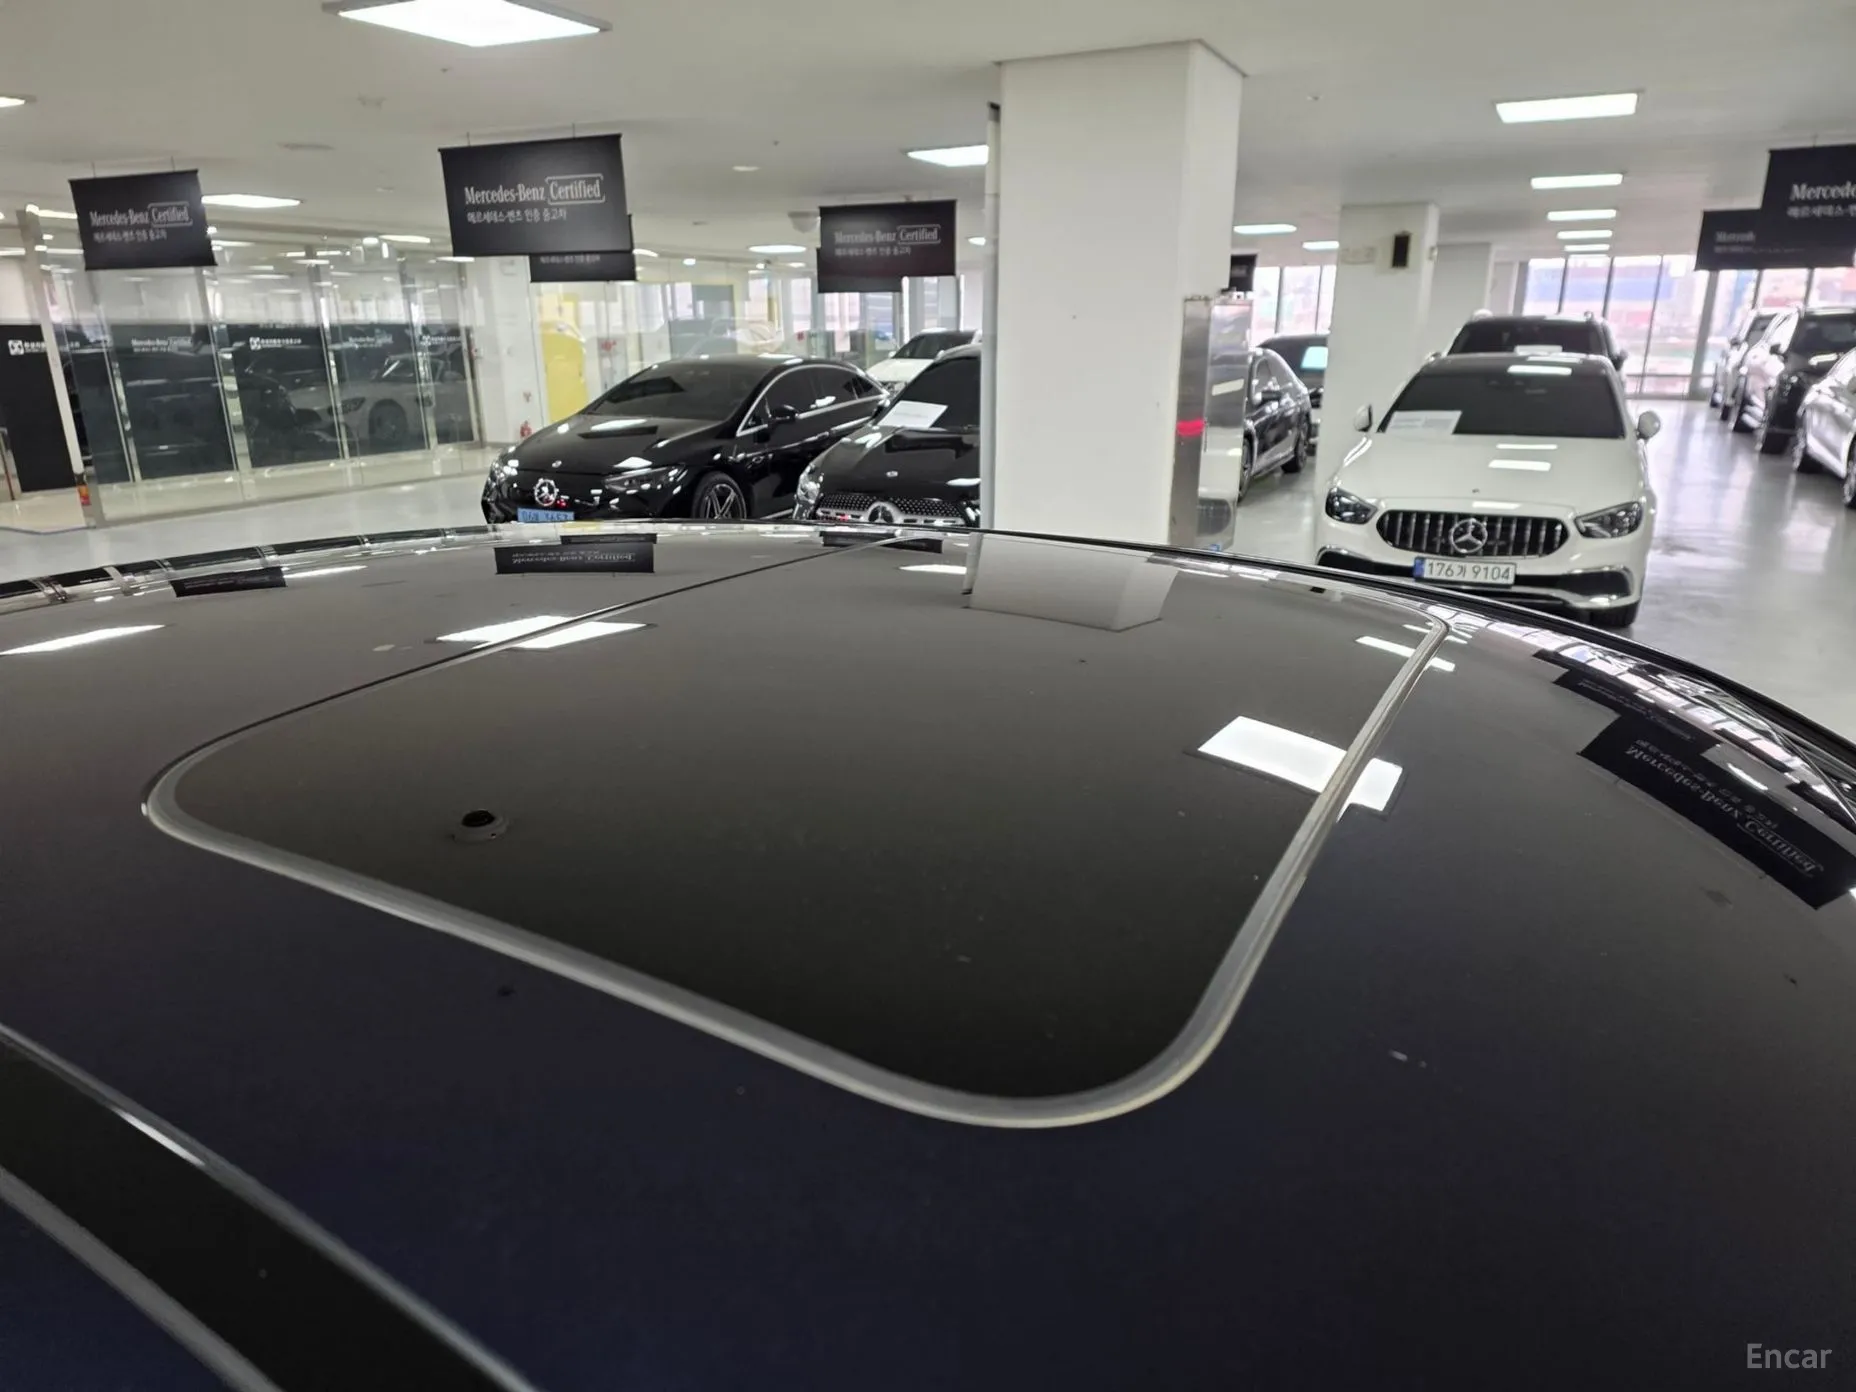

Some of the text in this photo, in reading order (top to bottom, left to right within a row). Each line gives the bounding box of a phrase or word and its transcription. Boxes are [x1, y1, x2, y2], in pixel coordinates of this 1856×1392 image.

[464, 179, 600, 205] Mercedes-Benz Certified
[90, 206, 189, 227] Mercedes-Benz Certified
[900, 228, 938, 241] Certified
[1428, 562, 1511, 580] 176가 9104
